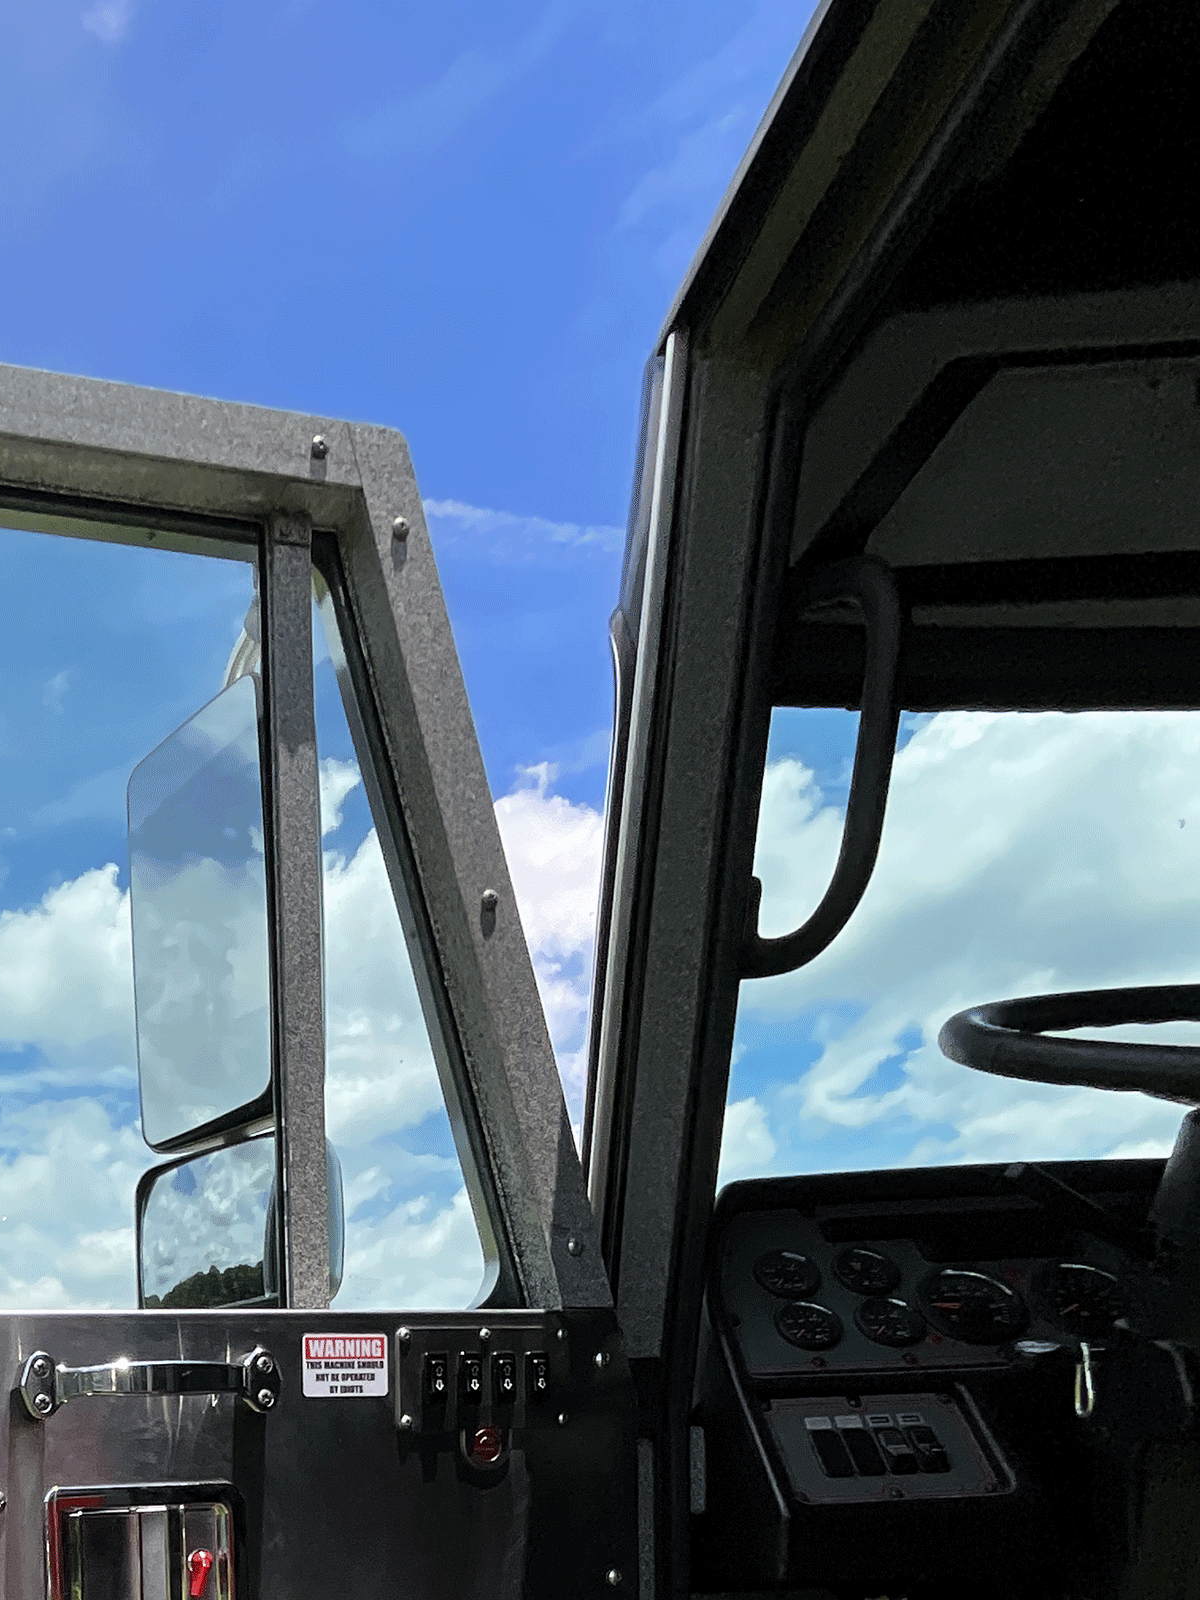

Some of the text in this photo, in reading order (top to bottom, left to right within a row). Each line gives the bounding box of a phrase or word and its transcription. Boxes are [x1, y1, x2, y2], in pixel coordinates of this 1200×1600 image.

[308, 1339, 382, 1358] WARNING
[306, 1361, 322, 1369] THIS
[324, 1361, 355, 1369] MACHINE
[316, 1373, 329, 1381] NOT
[341, 1372, 376, 1380] OPERATED
[329, 1385, 338, 1393] BY
